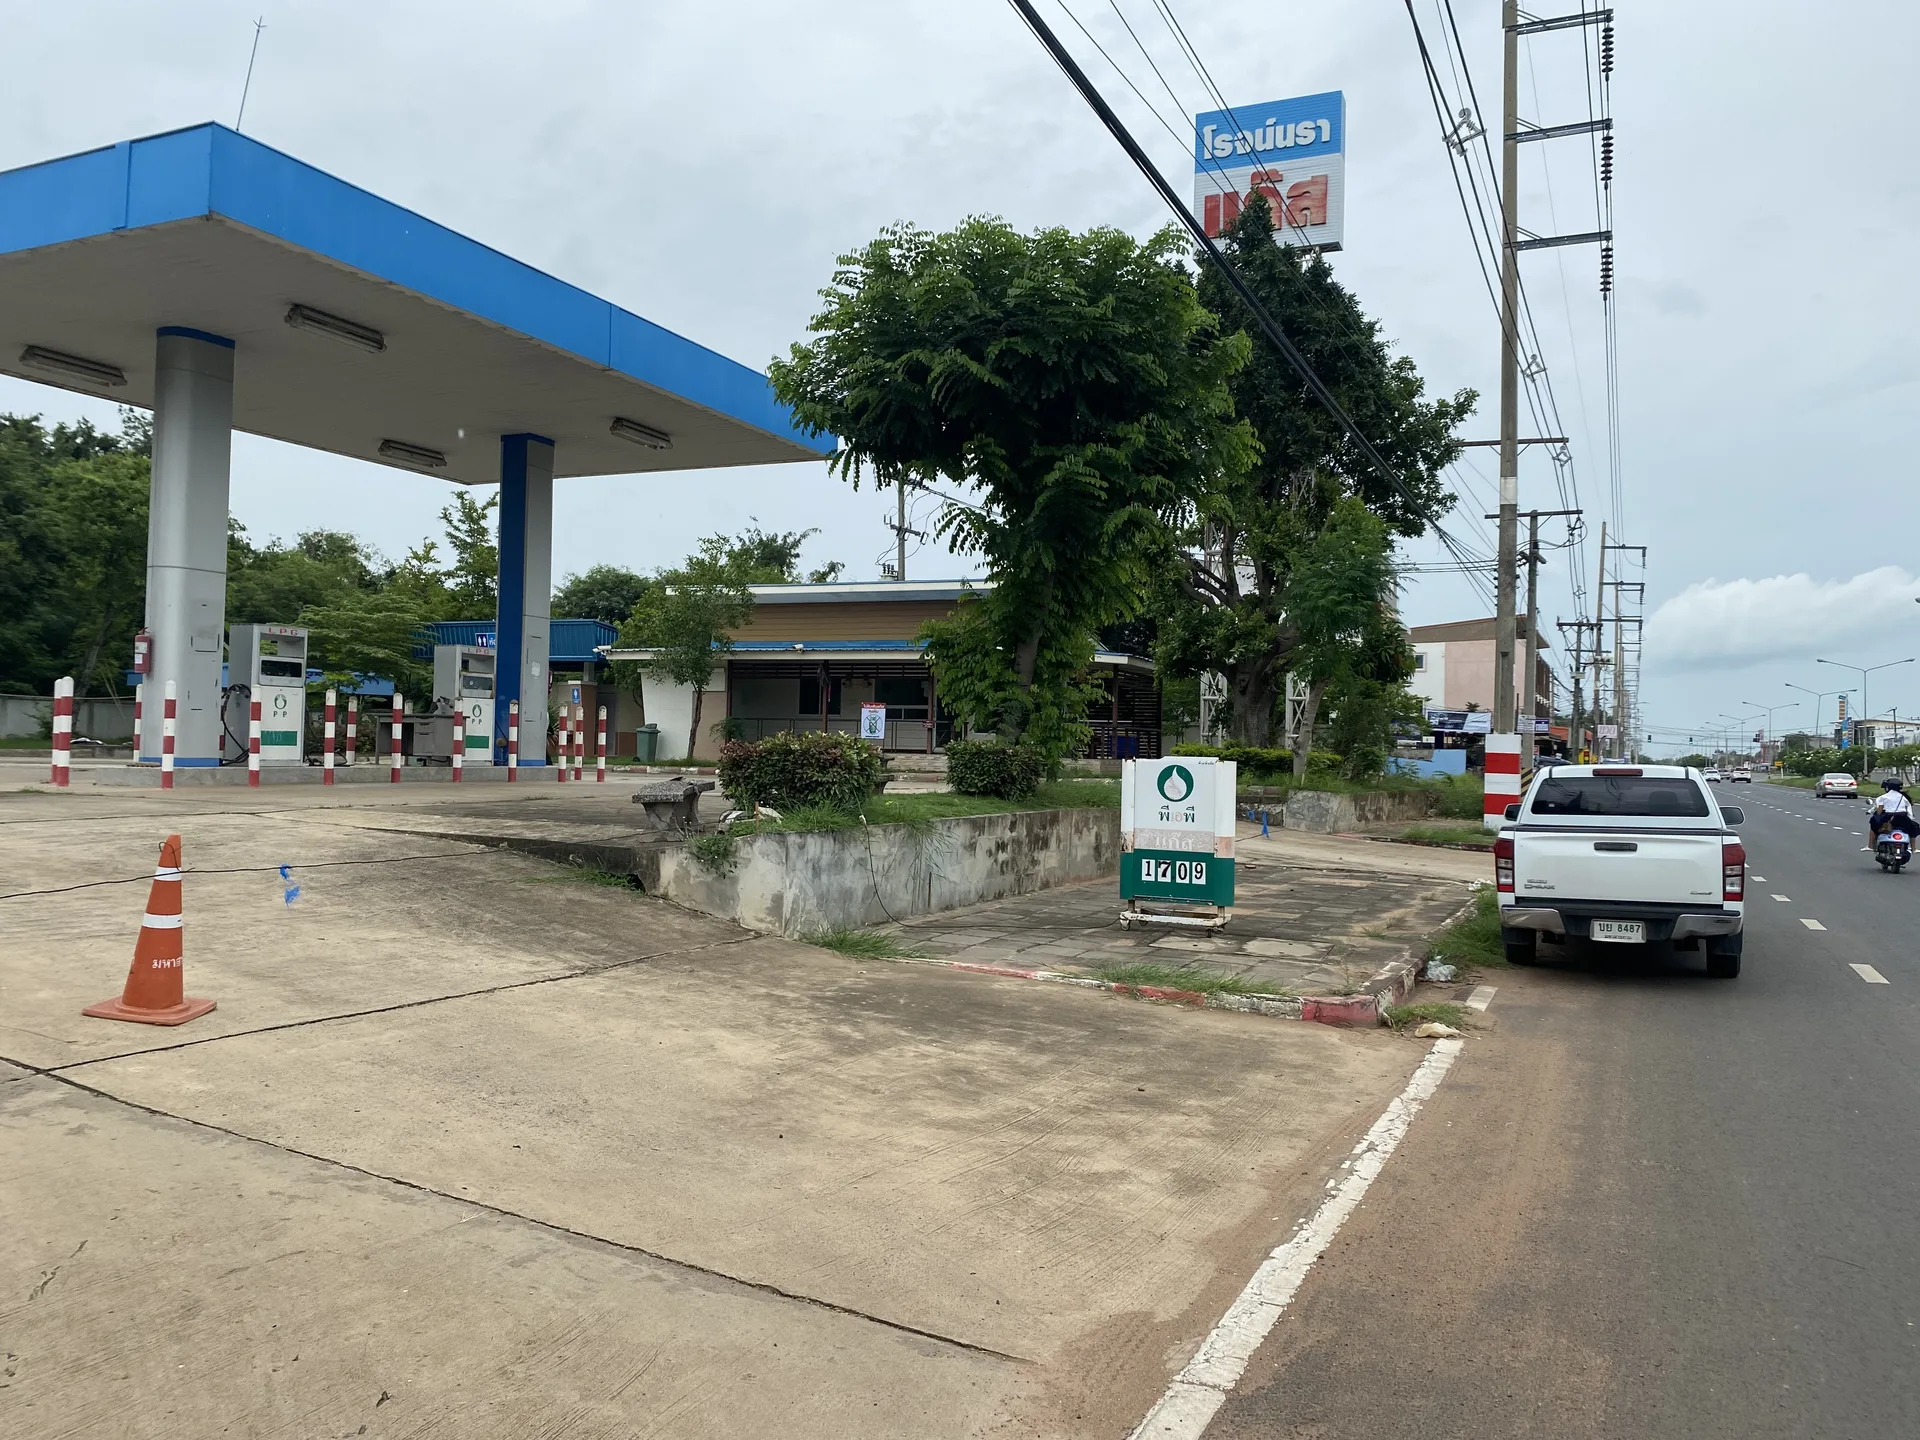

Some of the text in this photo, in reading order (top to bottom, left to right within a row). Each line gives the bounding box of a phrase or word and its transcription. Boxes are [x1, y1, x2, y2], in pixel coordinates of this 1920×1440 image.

[1203, 168, 1329, 239] แก๊ส
[268, 627, 298, 636] LPG
[1617, 923, 1641, 934] 8487
